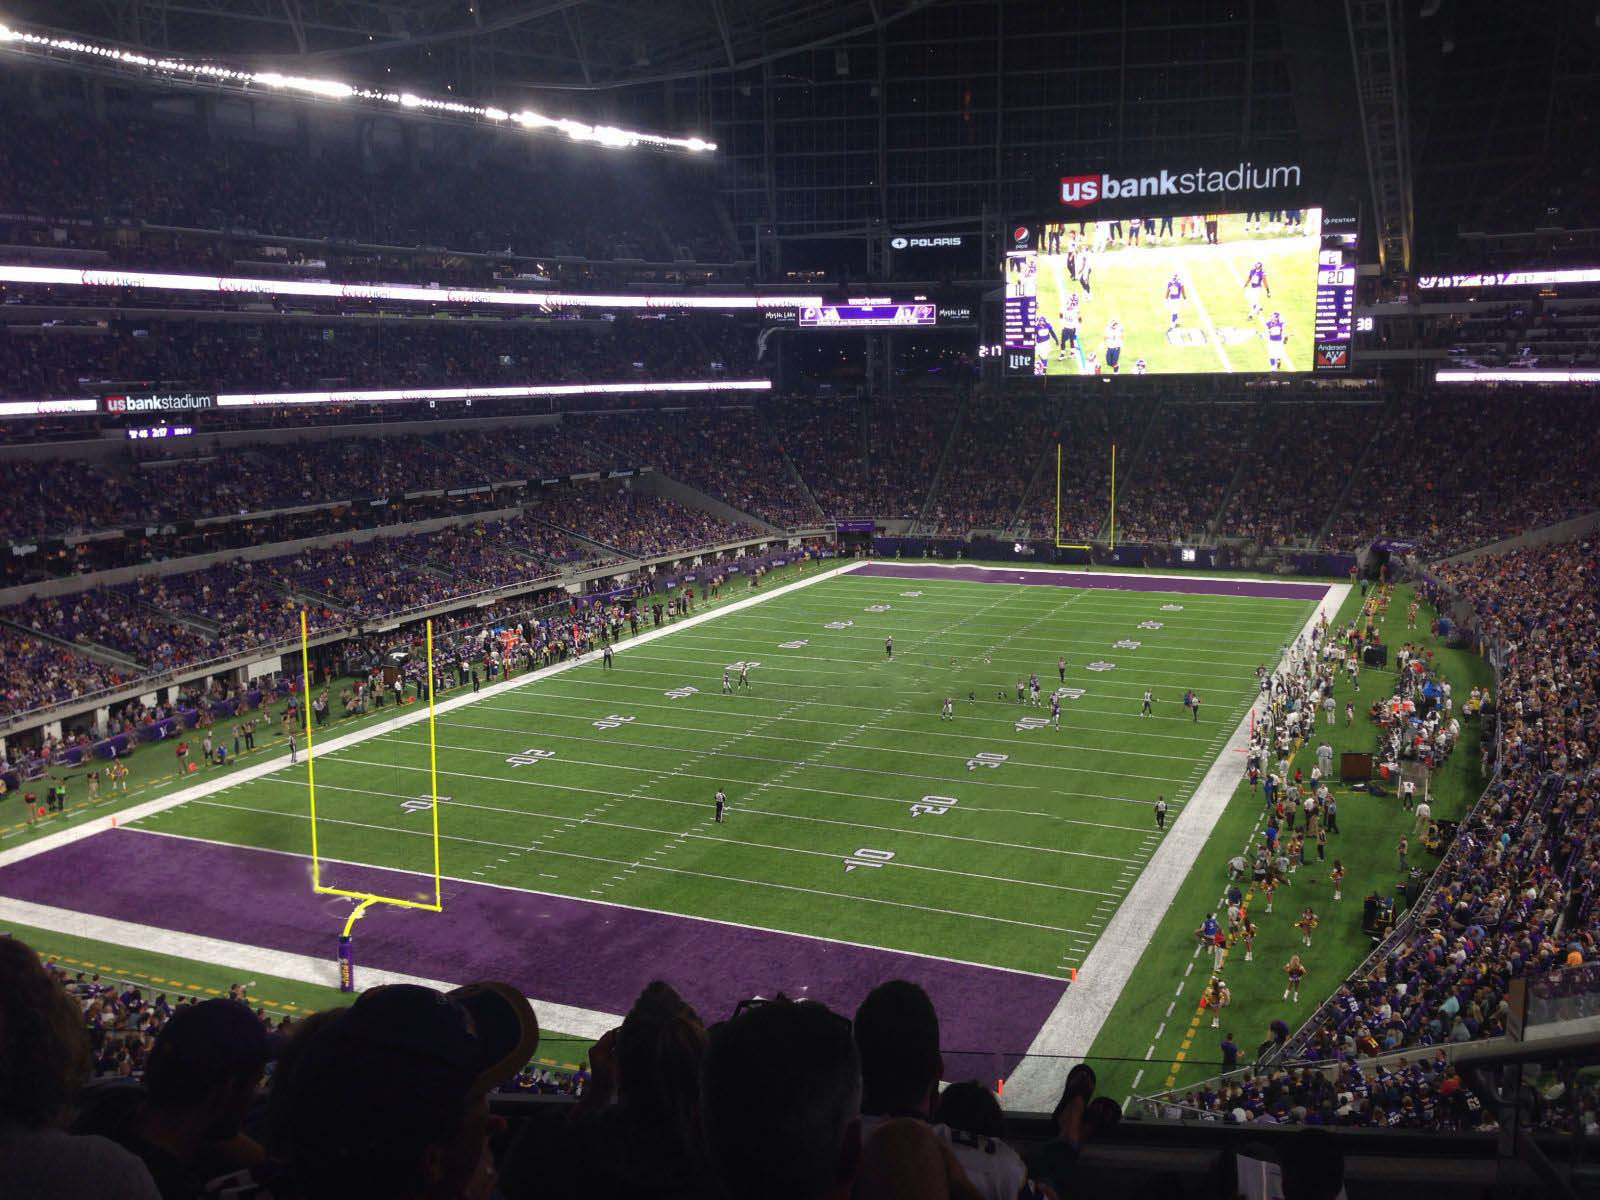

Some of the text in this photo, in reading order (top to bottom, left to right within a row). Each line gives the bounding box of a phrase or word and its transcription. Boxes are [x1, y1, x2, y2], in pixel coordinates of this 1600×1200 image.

[910, 237, 961, 247] POLARIS
[1327, 270, 1344, 285] 20
[1356, 317, 1373, 331] 38
[978, 344, 1002, 358] 2:17
[1317, 343, 1346, 351] Andersen
[1009, 353, 1031, 370] Lite
[592, 713, 637, 728] 30
[1015, 716, 1051, 730] 40
[504, 748, 556, 766] 20
[967, 751, 1009, 770] 30
[399, 793, 452, 811] 10
[910, 795, 959, 815] 20
[844, 847, 896, 869] 10
